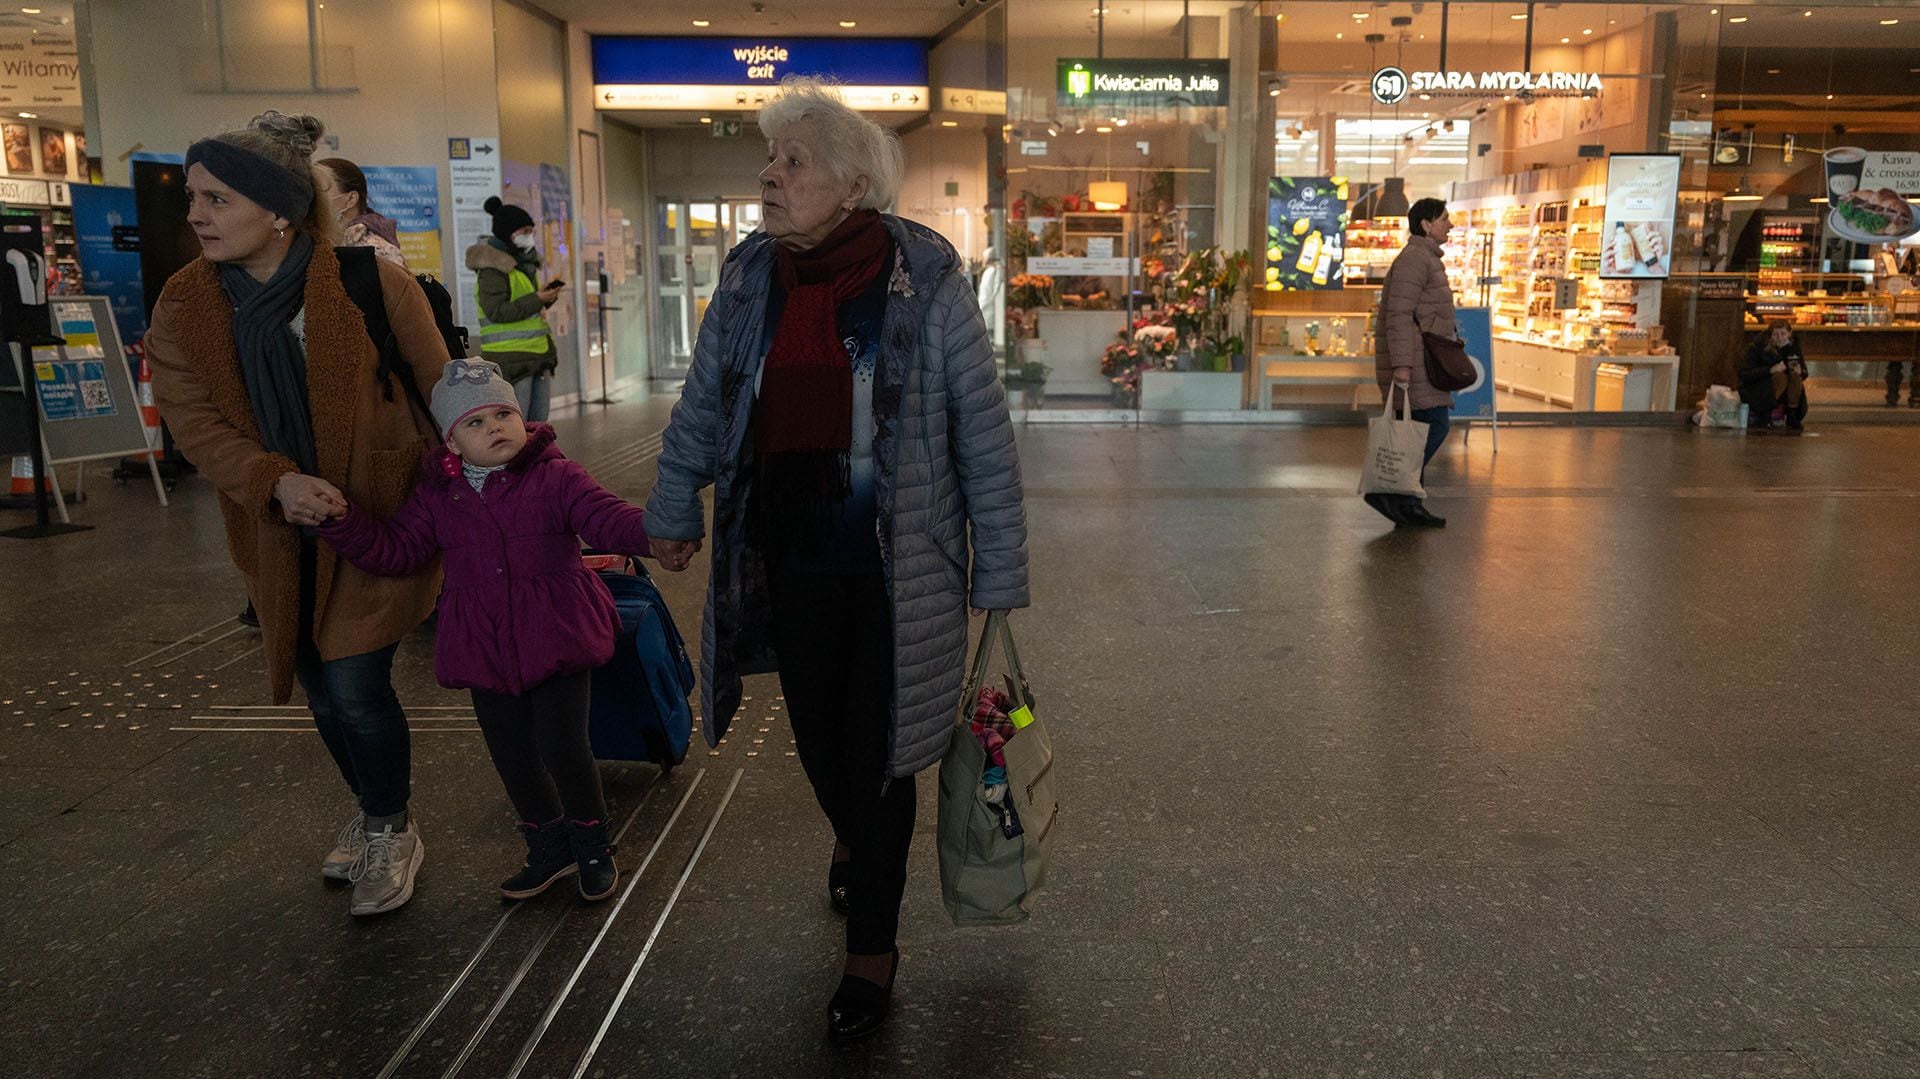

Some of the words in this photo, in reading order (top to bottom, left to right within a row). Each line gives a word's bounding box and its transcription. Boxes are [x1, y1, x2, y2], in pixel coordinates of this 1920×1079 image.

[734, 46, 788, 64] wyjście
[3, 60, 79, 80] Witamy
[747, 63, 775, 79] exit
[1094, 74, 1183, 92] Kwiaciarnia
[1185, 74, 1220, 92] Julia
[1411, 71, 1476, 90] STARA
[1479, 71, 1603, 90] MYDLARNIA
[1882, 153, 1912, 165] Kawa
[1864, 167, 1876, 178] &
